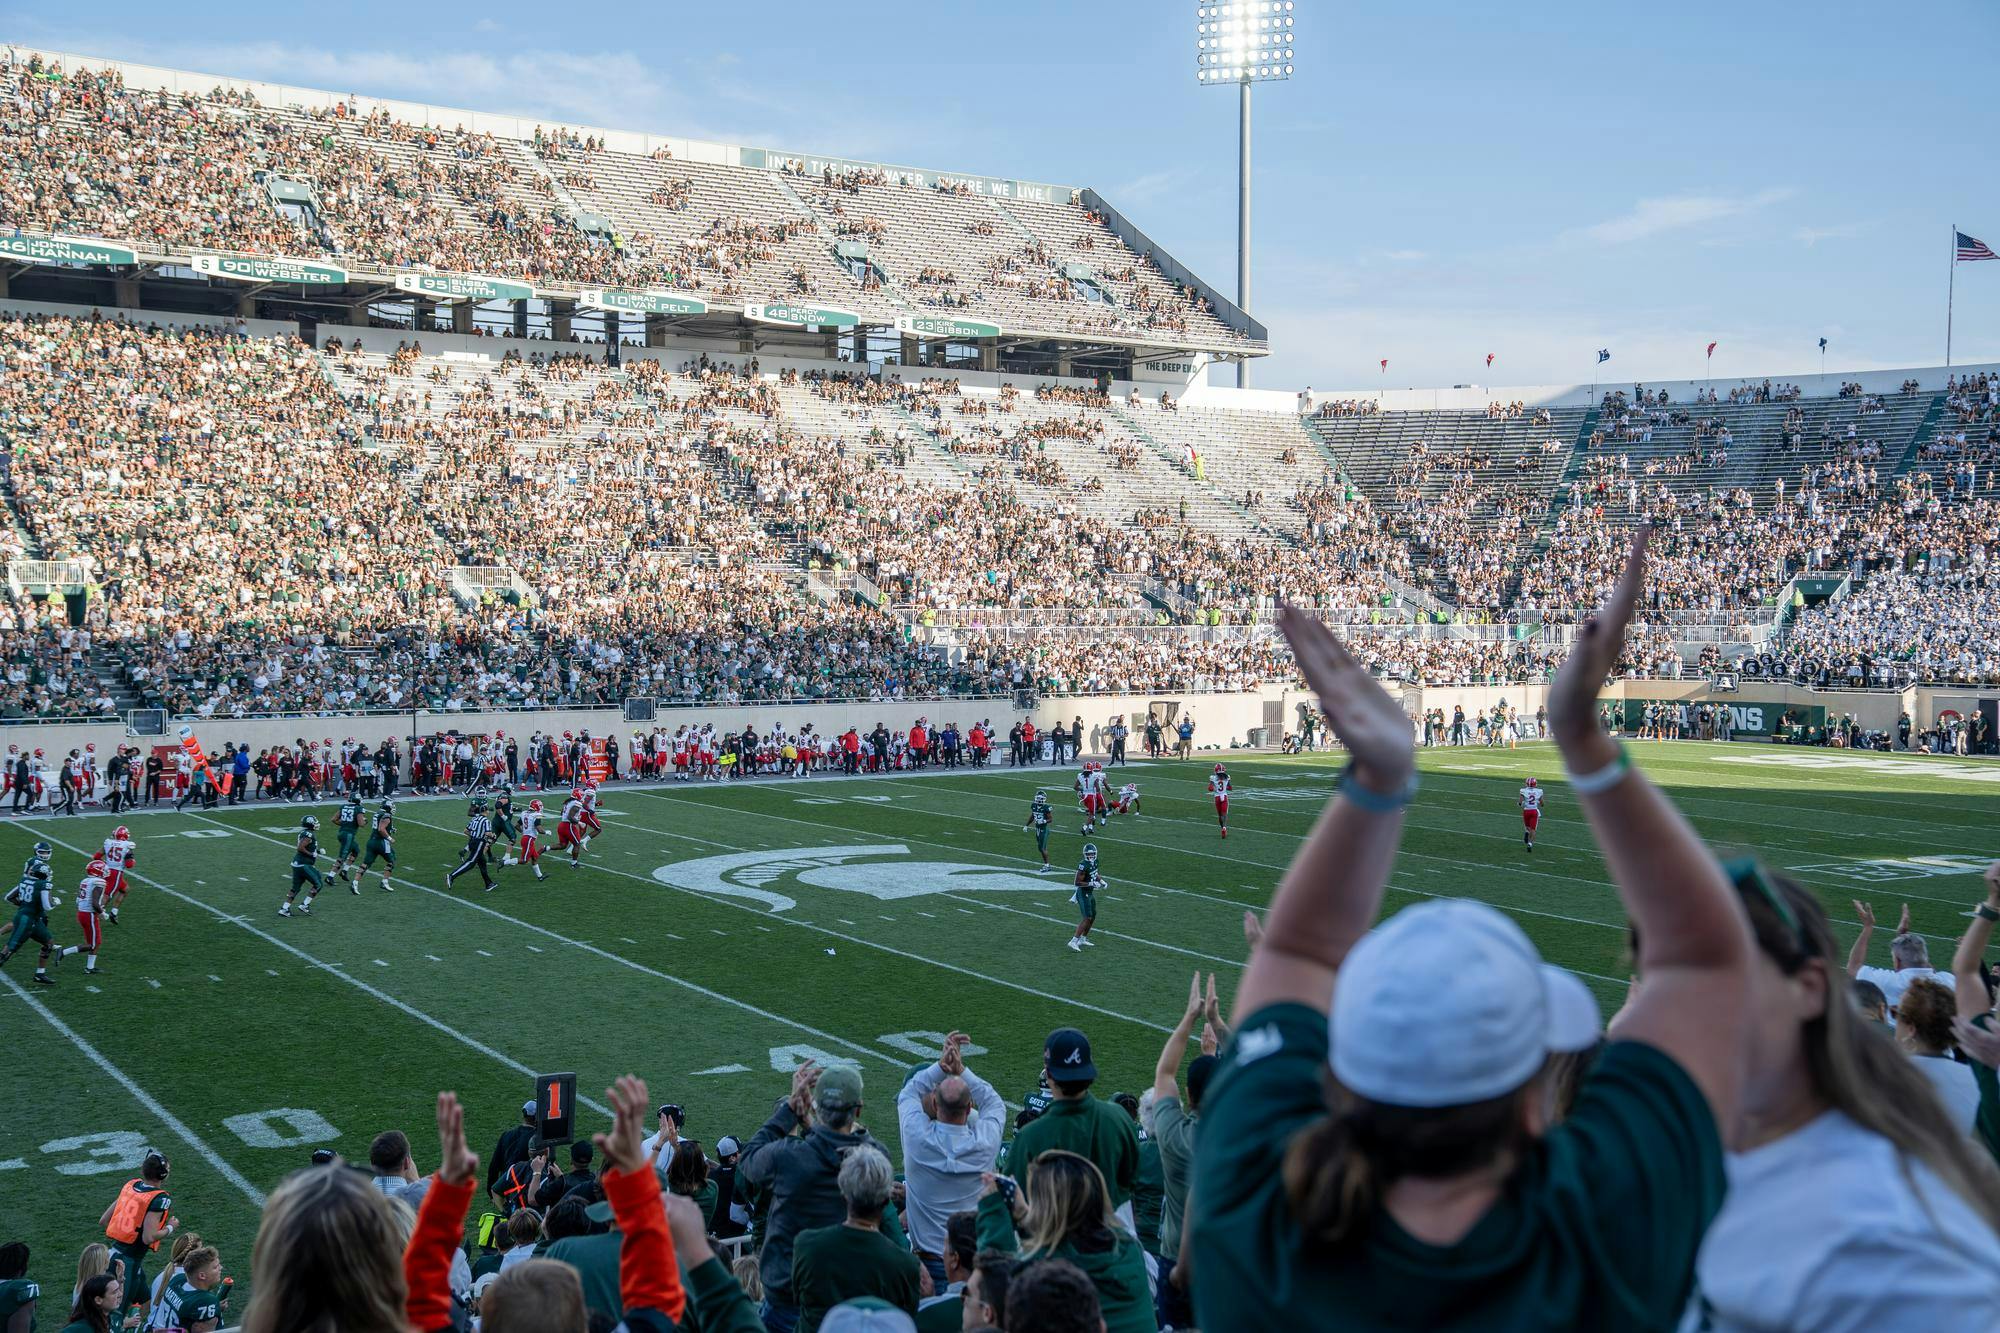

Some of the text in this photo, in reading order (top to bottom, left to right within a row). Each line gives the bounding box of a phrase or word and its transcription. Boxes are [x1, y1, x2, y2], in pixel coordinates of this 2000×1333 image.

[991, 183, 1009, 196] WE
[31, 241, 70, 250] JOHN
[31, 247, 110, 262] HANNAH
[223, 261, 250, 273] 90
[255, 262, 305, 272] GEORGE
[255, 268, 331, 282] WEBSTER
[424, 279, 448, 290] 95
[452, 279, 488, 288] BUBBA
[452, 285, 496, 296] SMITH
[610, 295, 627, 306] 10
[631, 301, 690, 313] VAN PELT
[768, 308, 788, 318] 48
[791, 307, 818, 315] PERCY
[790, 313, 826, 322] SNOW
[916, 321, 934, 331] 23
[936, 326, 979, 336] GIBSON
[1145, 361, 1197, 373] THE DEEP END
[1085, 778, 1089, 790] 1
[1217, 781, 1224, 792] 3
[1529, 794, 1536, 806] 2
[341, 808, 355, 823] 53
[523, 816, 529, 830] 9
[106, 846, 123, 863] 45
[18, 883, 35, 903] 58
[875, 1030, 989, 1060] 0
[1064, 1047, 1082, 1065] A
[547, 1081, 562, 1120] 1
[38, 1107, 343, 1176] 3 0
[160, 1197, 172, 1210] 18
[26, 1283, 40, 1298] 71
[197, 1304, 217, 1320] 76
